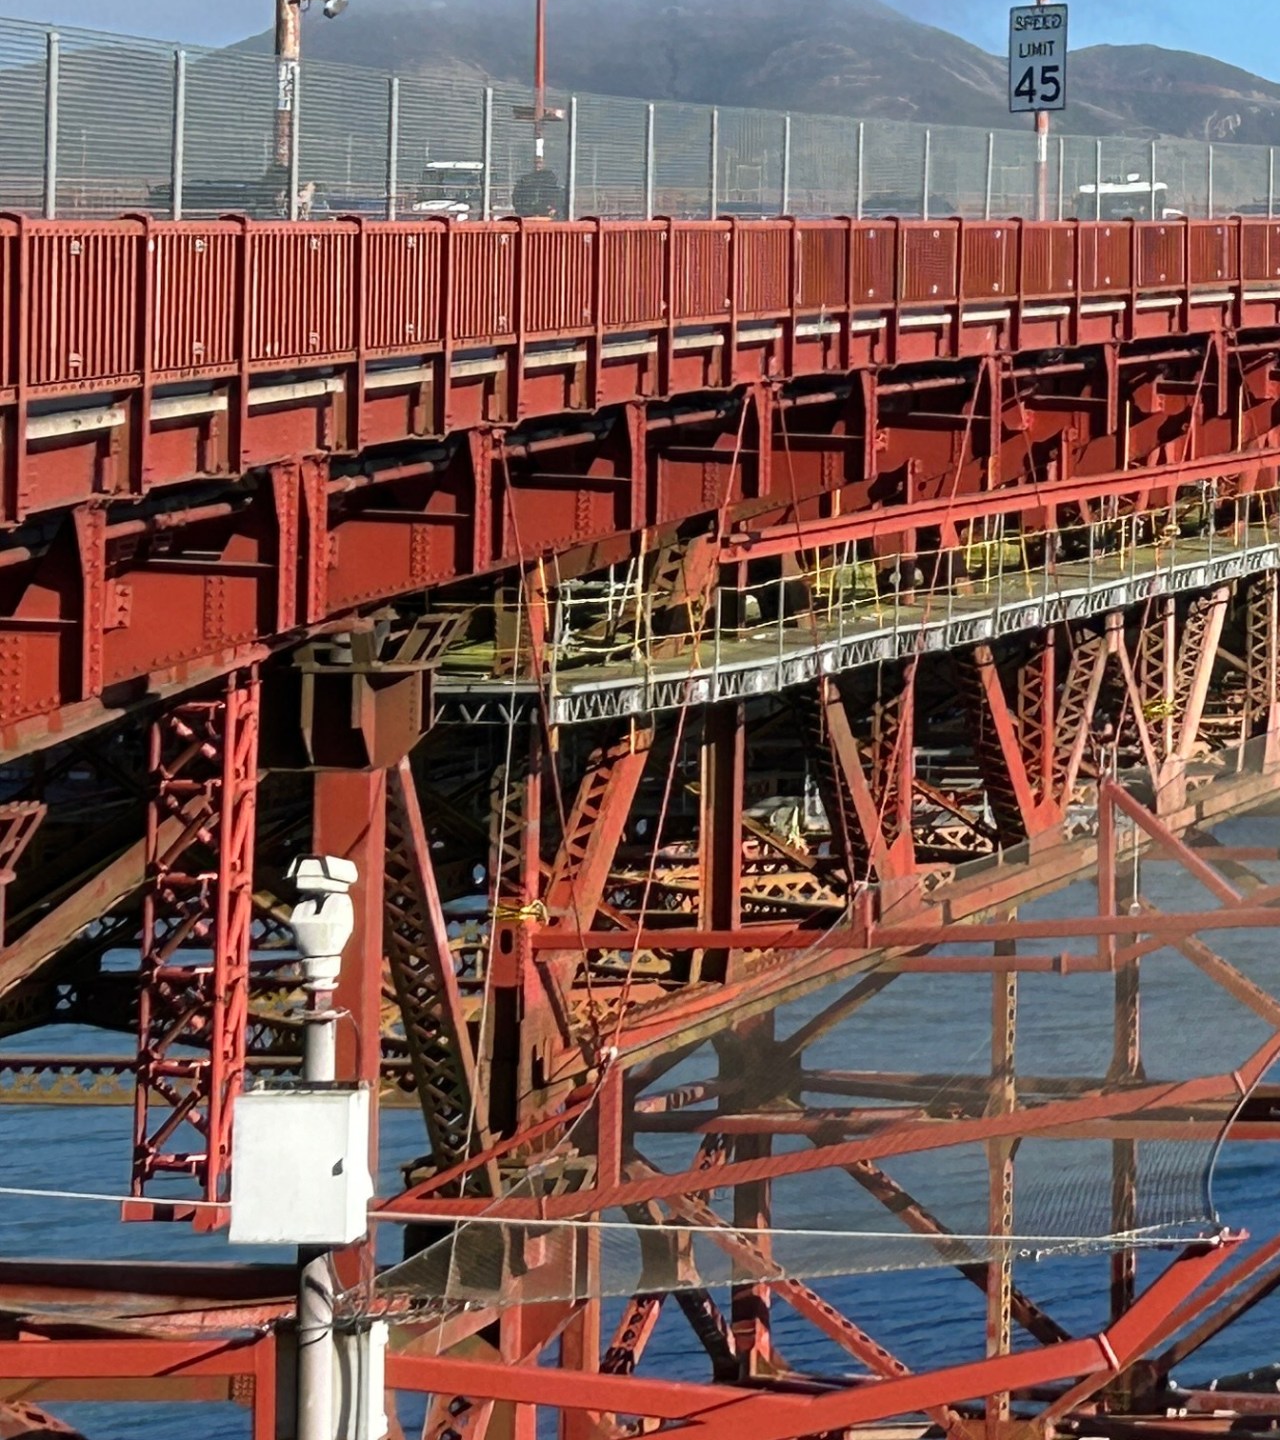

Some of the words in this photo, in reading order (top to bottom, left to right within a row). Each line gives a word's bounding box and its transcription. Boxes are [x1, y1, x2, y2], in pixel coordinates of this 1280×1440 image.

[1014, 13, 1062, 31] SPEED
[1018, 40, 1055, 58] LIMIT
[1014, 64, 1061, 103] 45
